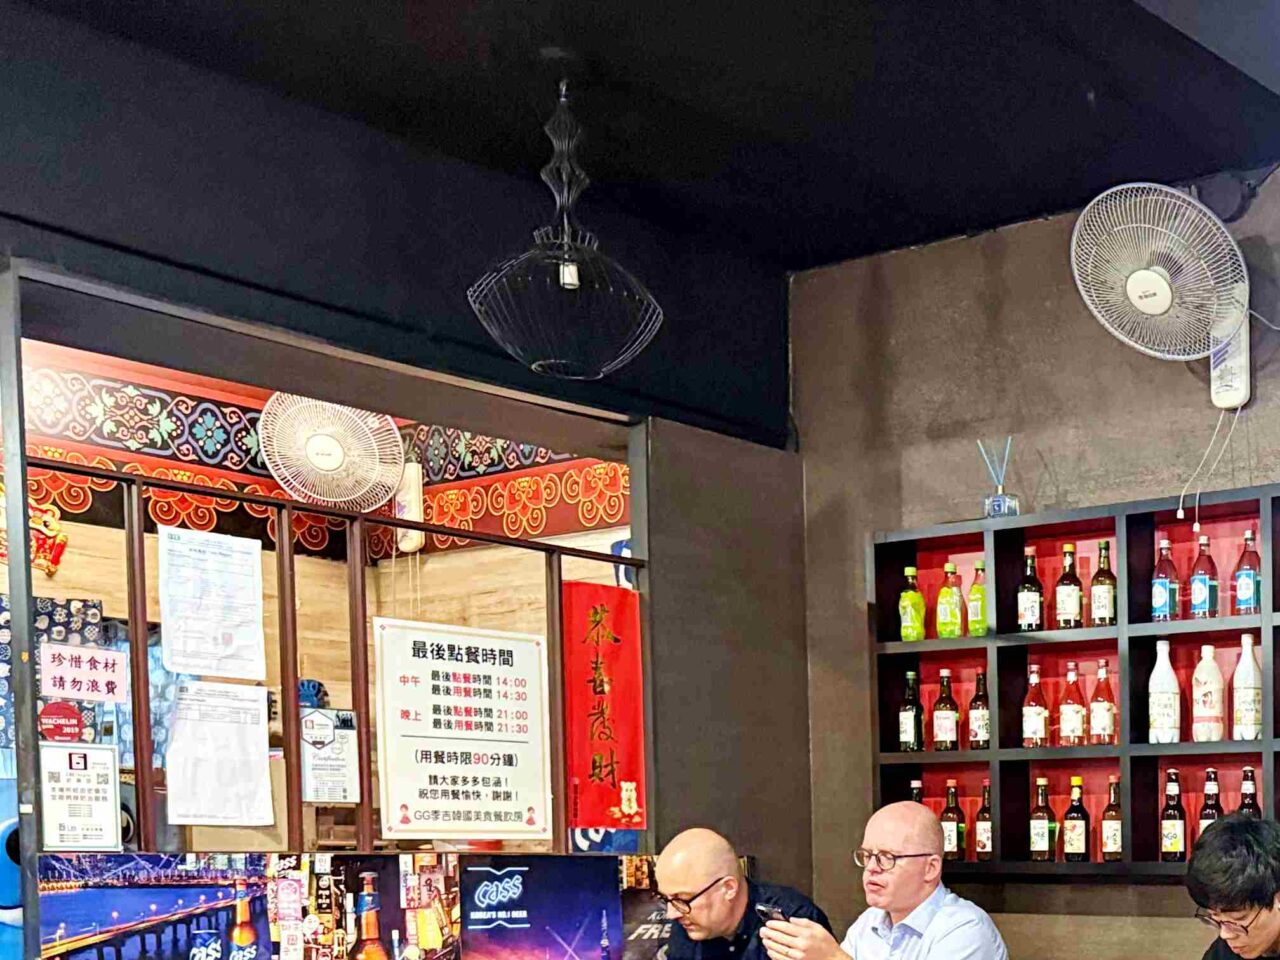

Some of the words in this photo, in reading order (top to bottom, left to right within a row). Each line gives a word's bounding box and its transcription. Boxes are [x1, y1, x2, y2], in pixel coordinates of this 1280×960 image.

[411, 640, 514, 667] 最後點餐時間
[51, 652, 118, 673] 珍惜食材
[51, 675, 117, 695] 請勿浪費
[399, 674, 421, 687] 中午
[431, 670, 493, 686] 最後點餐時間
[496, 676, 527, 688] 14:00
[431, 684, 493, 700] 最後用餐時間
[496, 690, 527, 701] 14:30
[400, 709, 422, 721] 晚上
[432, 704, 494, 720] 最後點餐時間
[497, 709, 528, 721] 21:00
[432, 718, 494, 733] 最後用餐時間
[497, 723, 529, 734] 21:30
[627, 923, 672, 940] FRE
